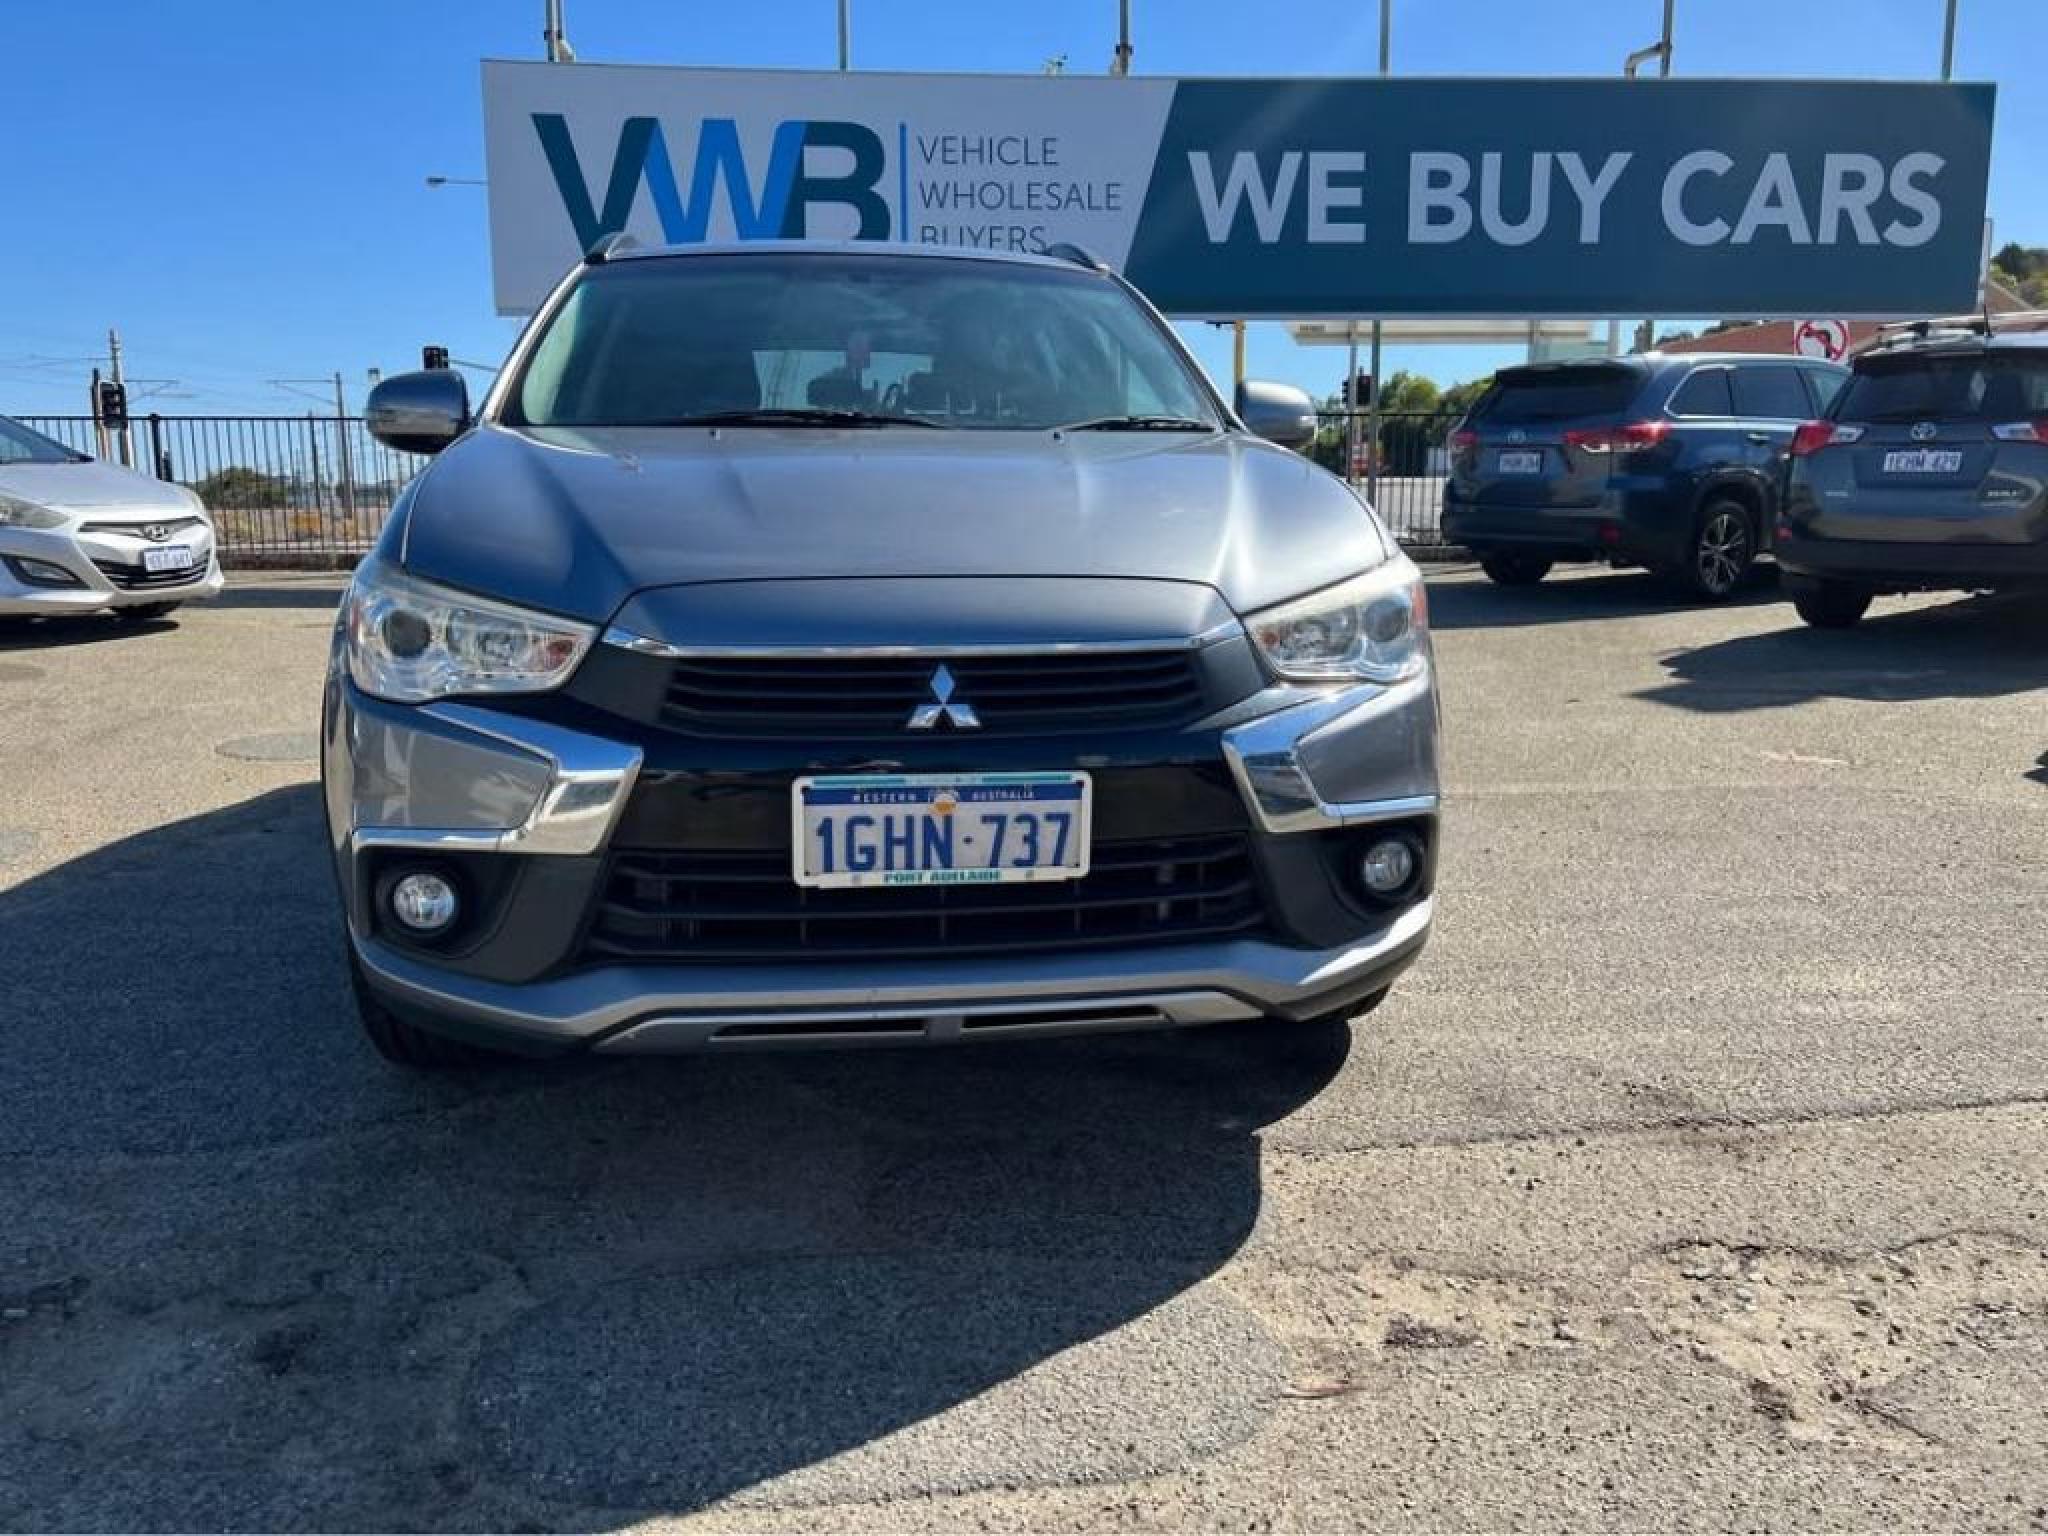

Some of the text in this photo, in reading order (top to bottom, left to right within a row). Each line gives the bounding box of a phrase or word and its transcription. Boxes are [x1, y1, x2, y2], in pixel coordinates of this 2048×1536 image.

[918, 135, 1058, 167] VEHICLE
[918, 181, 1122, 211] WHOLESALE
[1187, 150, 1946, 247] WE BUY CARS
[921, 225, 1046, 254] BUYERS
